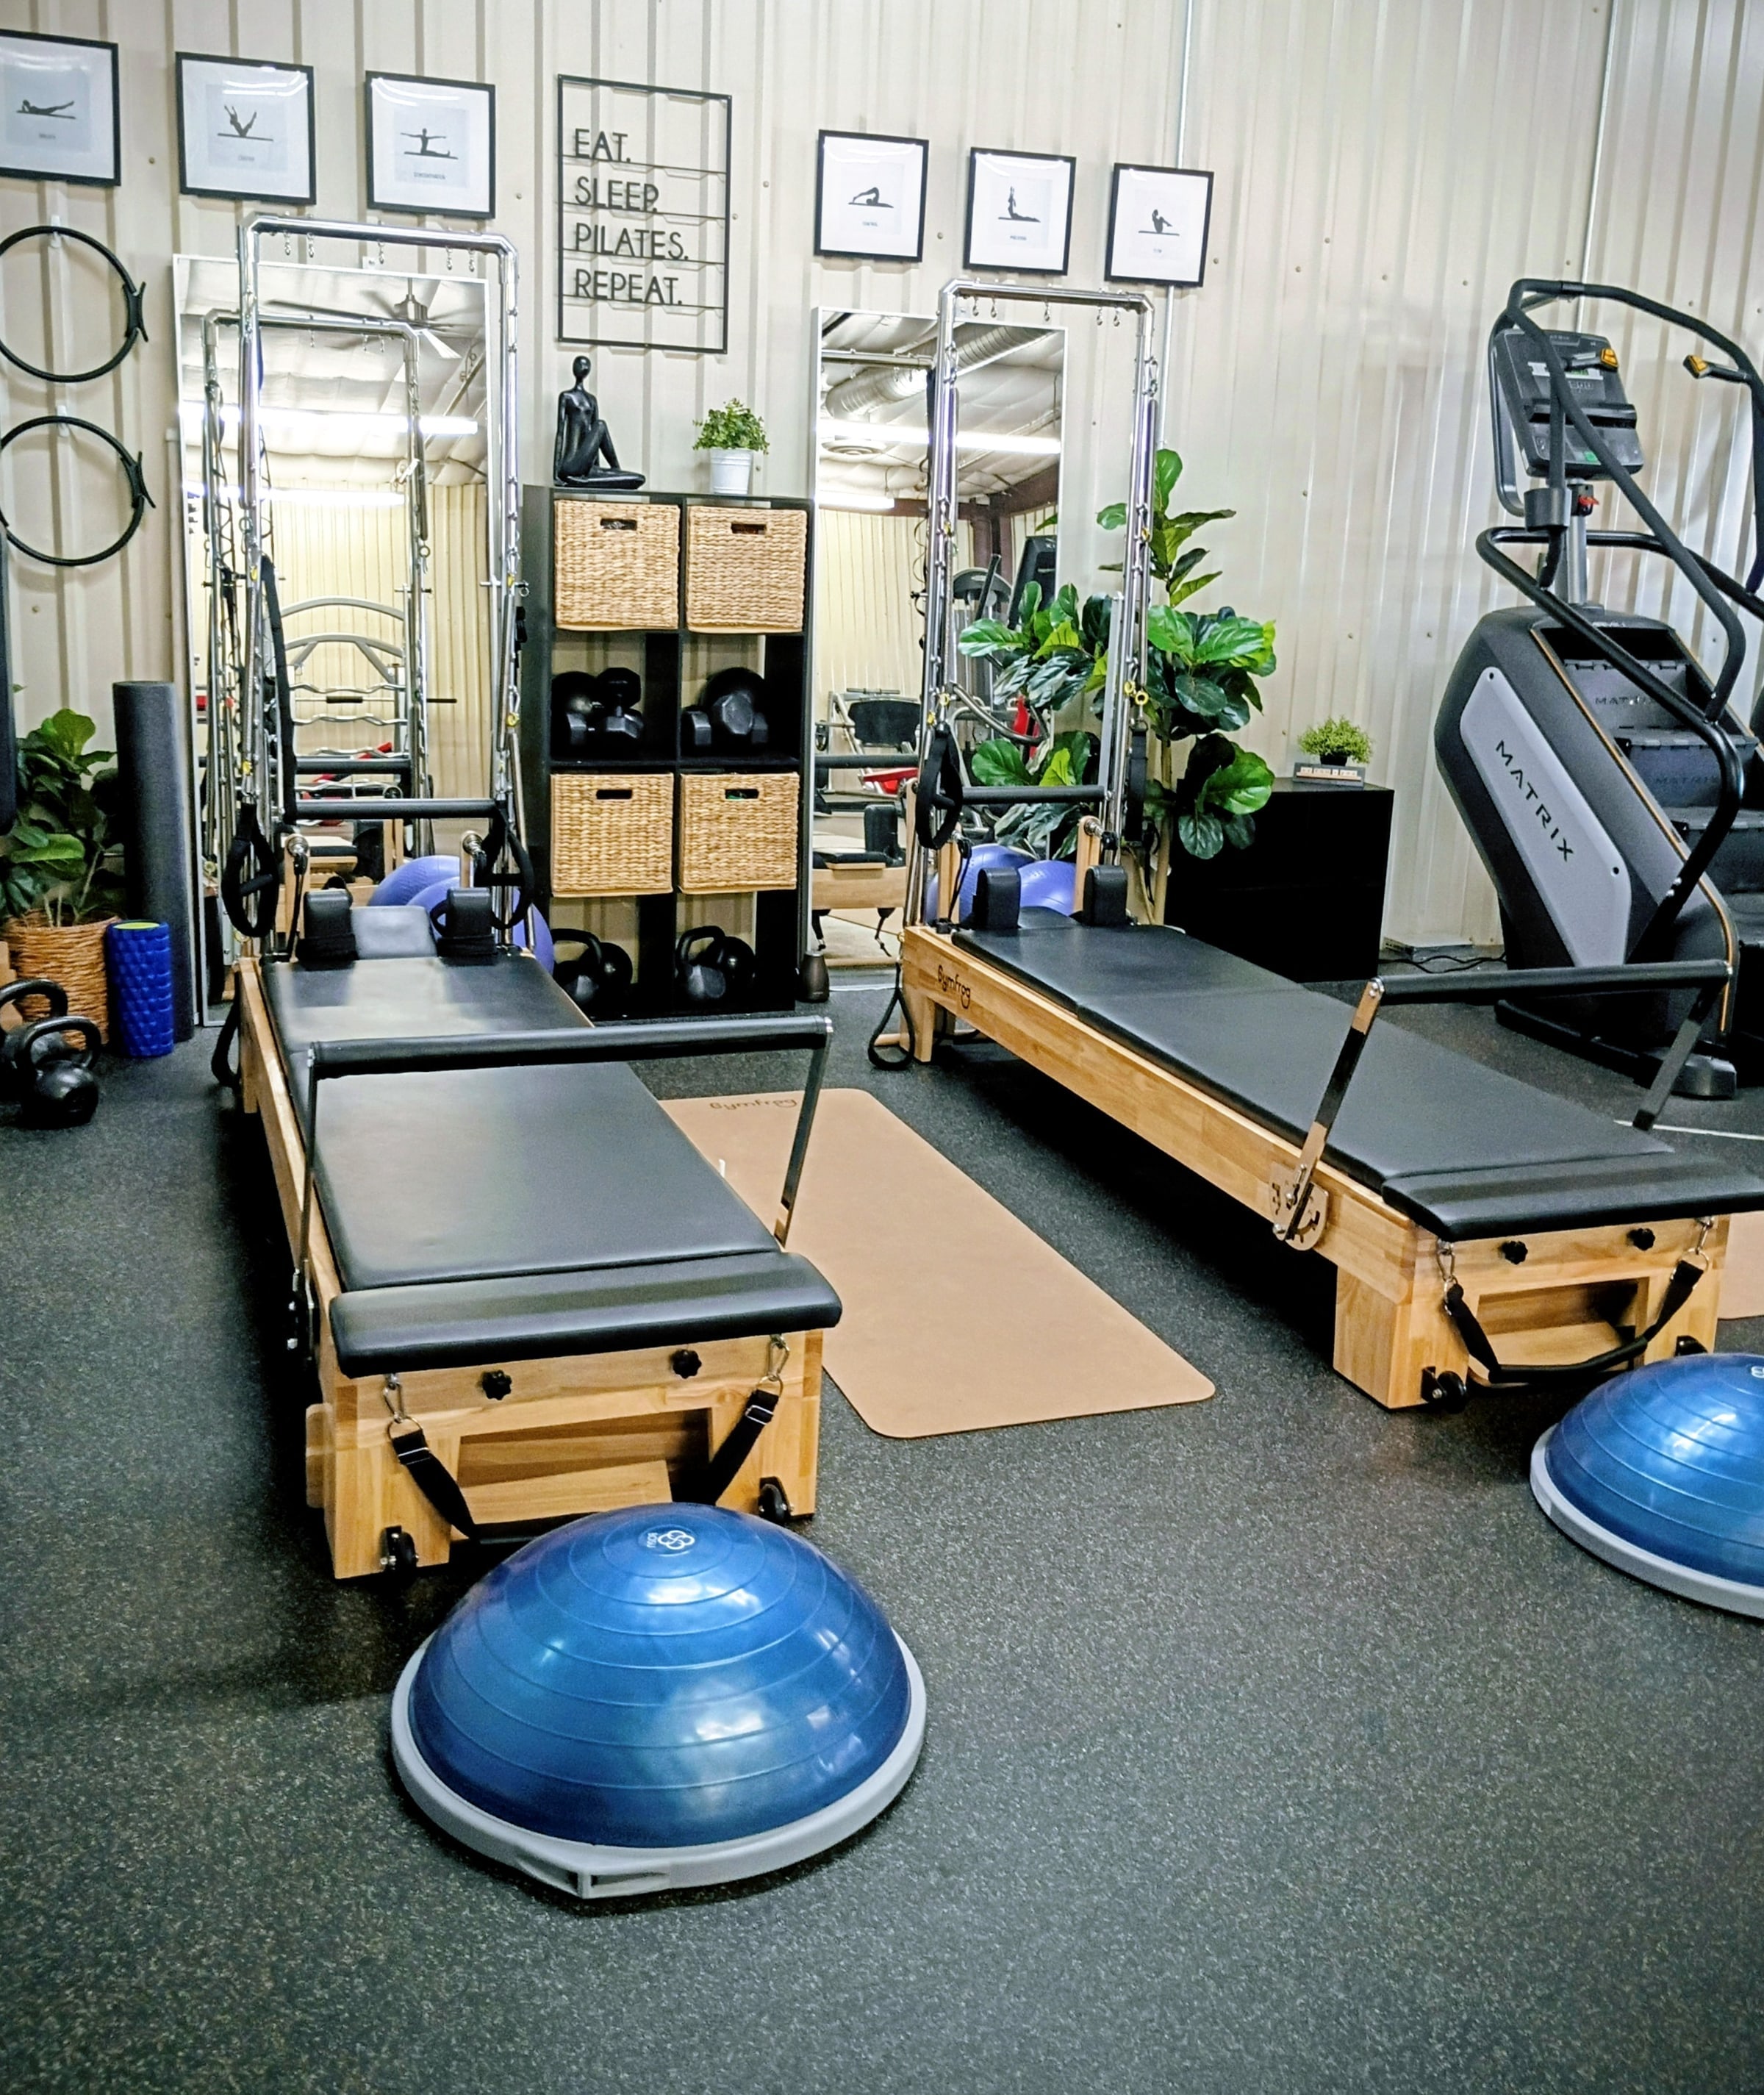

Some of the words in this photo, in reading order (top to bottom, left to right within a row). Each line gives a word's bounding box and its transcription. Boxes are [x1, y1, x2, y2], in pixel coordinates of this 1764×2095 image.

[575, 128, 631, 162] EAT.
[575, 176, 659, 212] SLEEP.
[575, 222, 689, 261] PILATES.
[575, 268, 683, 305] REPEAT.
[1495, 739, 1574, 862] MATRIX
[937, 964, 971, 1010] Gymfrog
